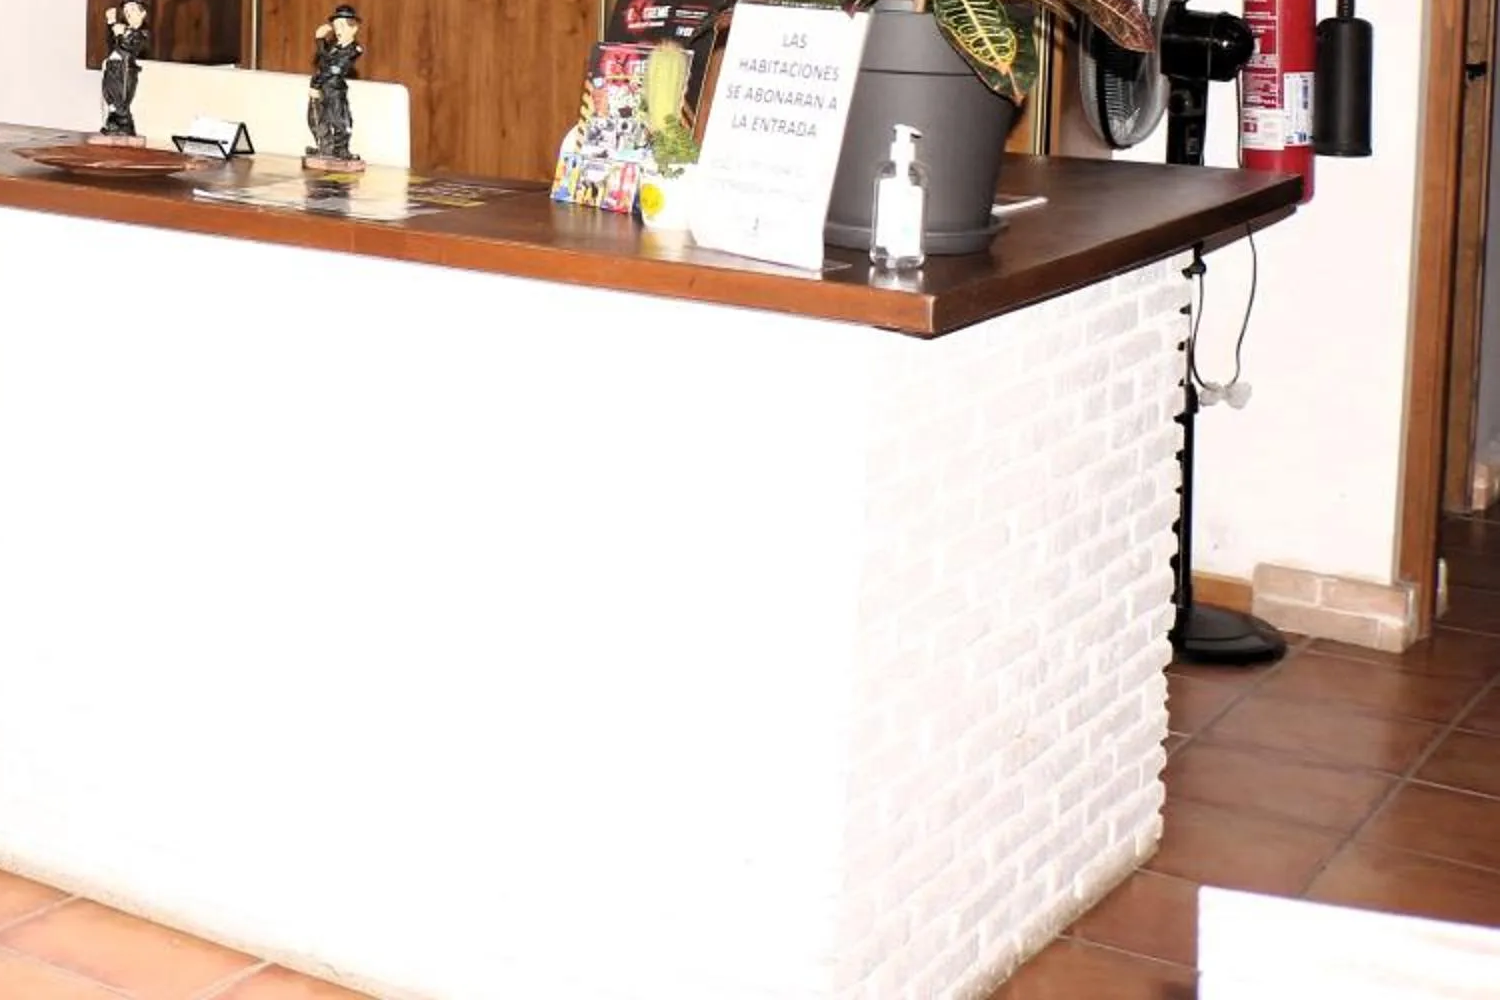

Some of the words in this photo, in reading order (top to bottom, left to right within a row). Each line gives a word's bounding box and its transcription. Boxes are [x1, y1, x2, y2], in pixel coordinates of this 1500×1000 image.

[781, 32, 808, 49] LAS
[739, 58, 840, 81] HABITACIONES
[726, 83, 742, 100] SE
[744, 87, 825, 110] ABONARAN
[828, 96, 838, 110] A
[731, 114, 748, 129] LA
[751, 116, 818, 138] ENTRADA
